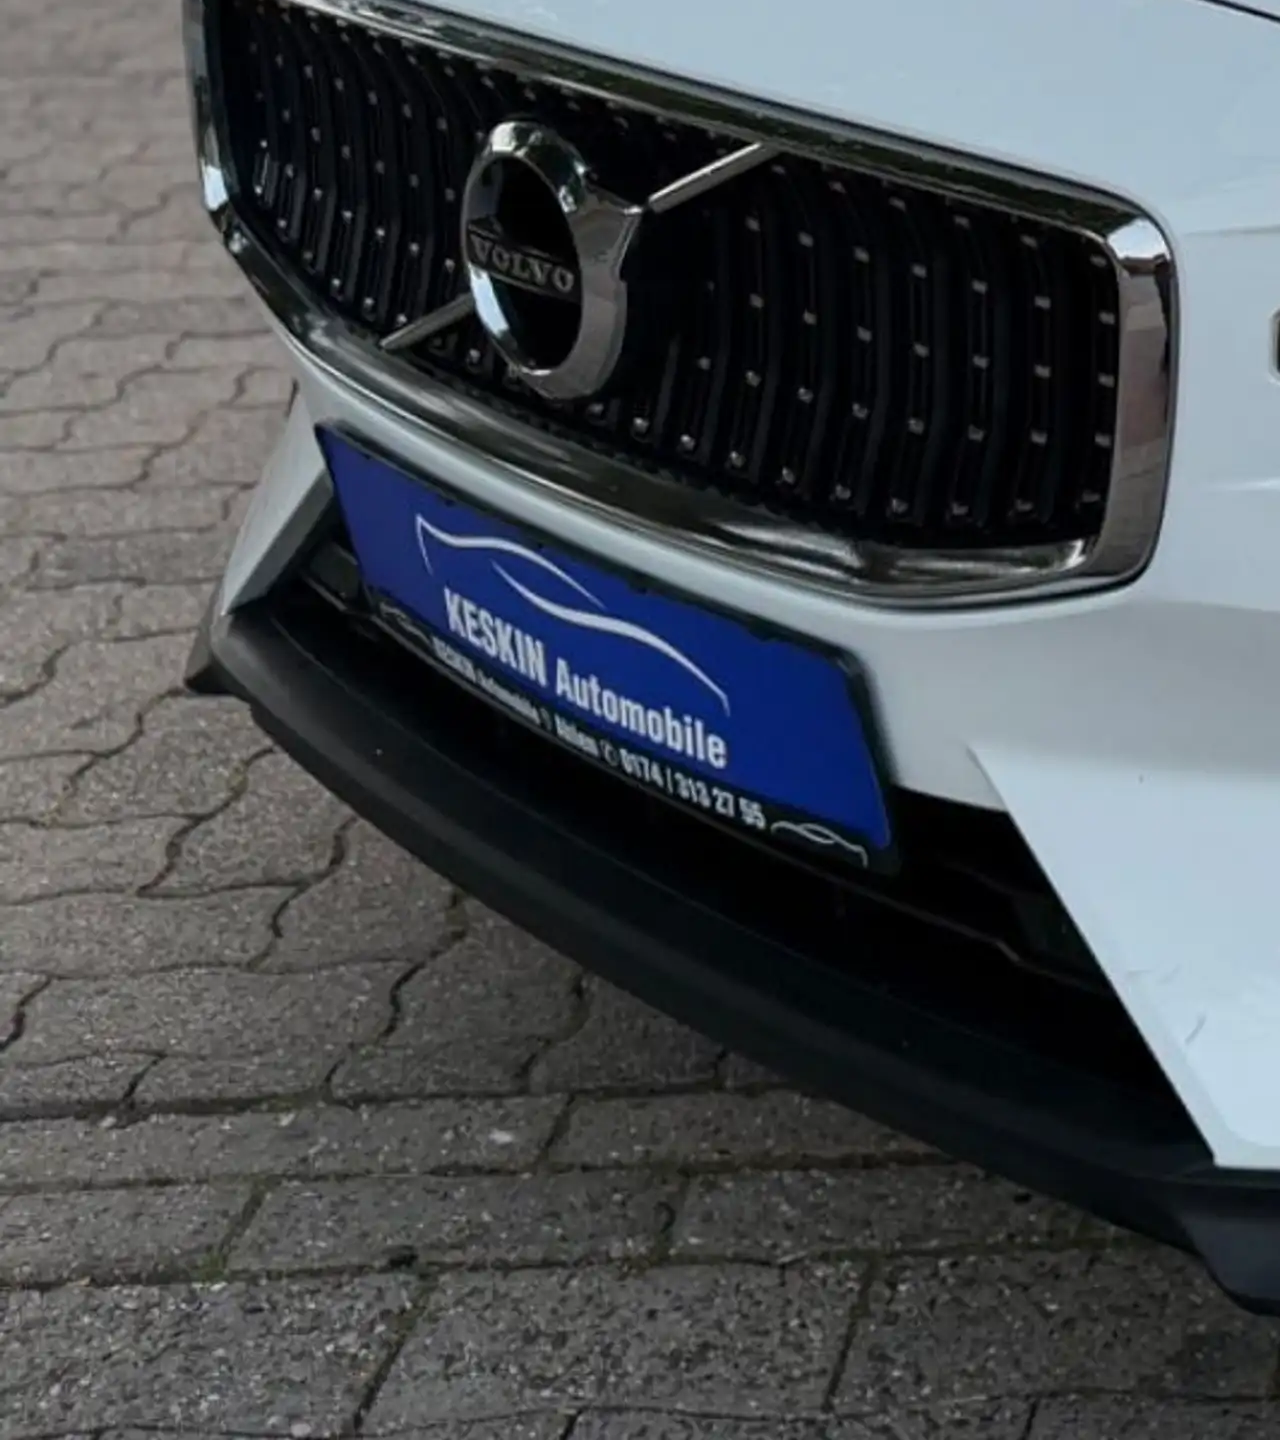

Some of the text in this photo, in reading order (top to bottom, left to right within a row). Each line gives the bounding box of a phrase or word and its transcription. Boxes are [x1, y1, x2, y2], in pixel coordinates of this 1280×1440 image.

[469, 232, 575, 294] VOLVO
[443, 584, 728, 770] KESKIN Automobile
